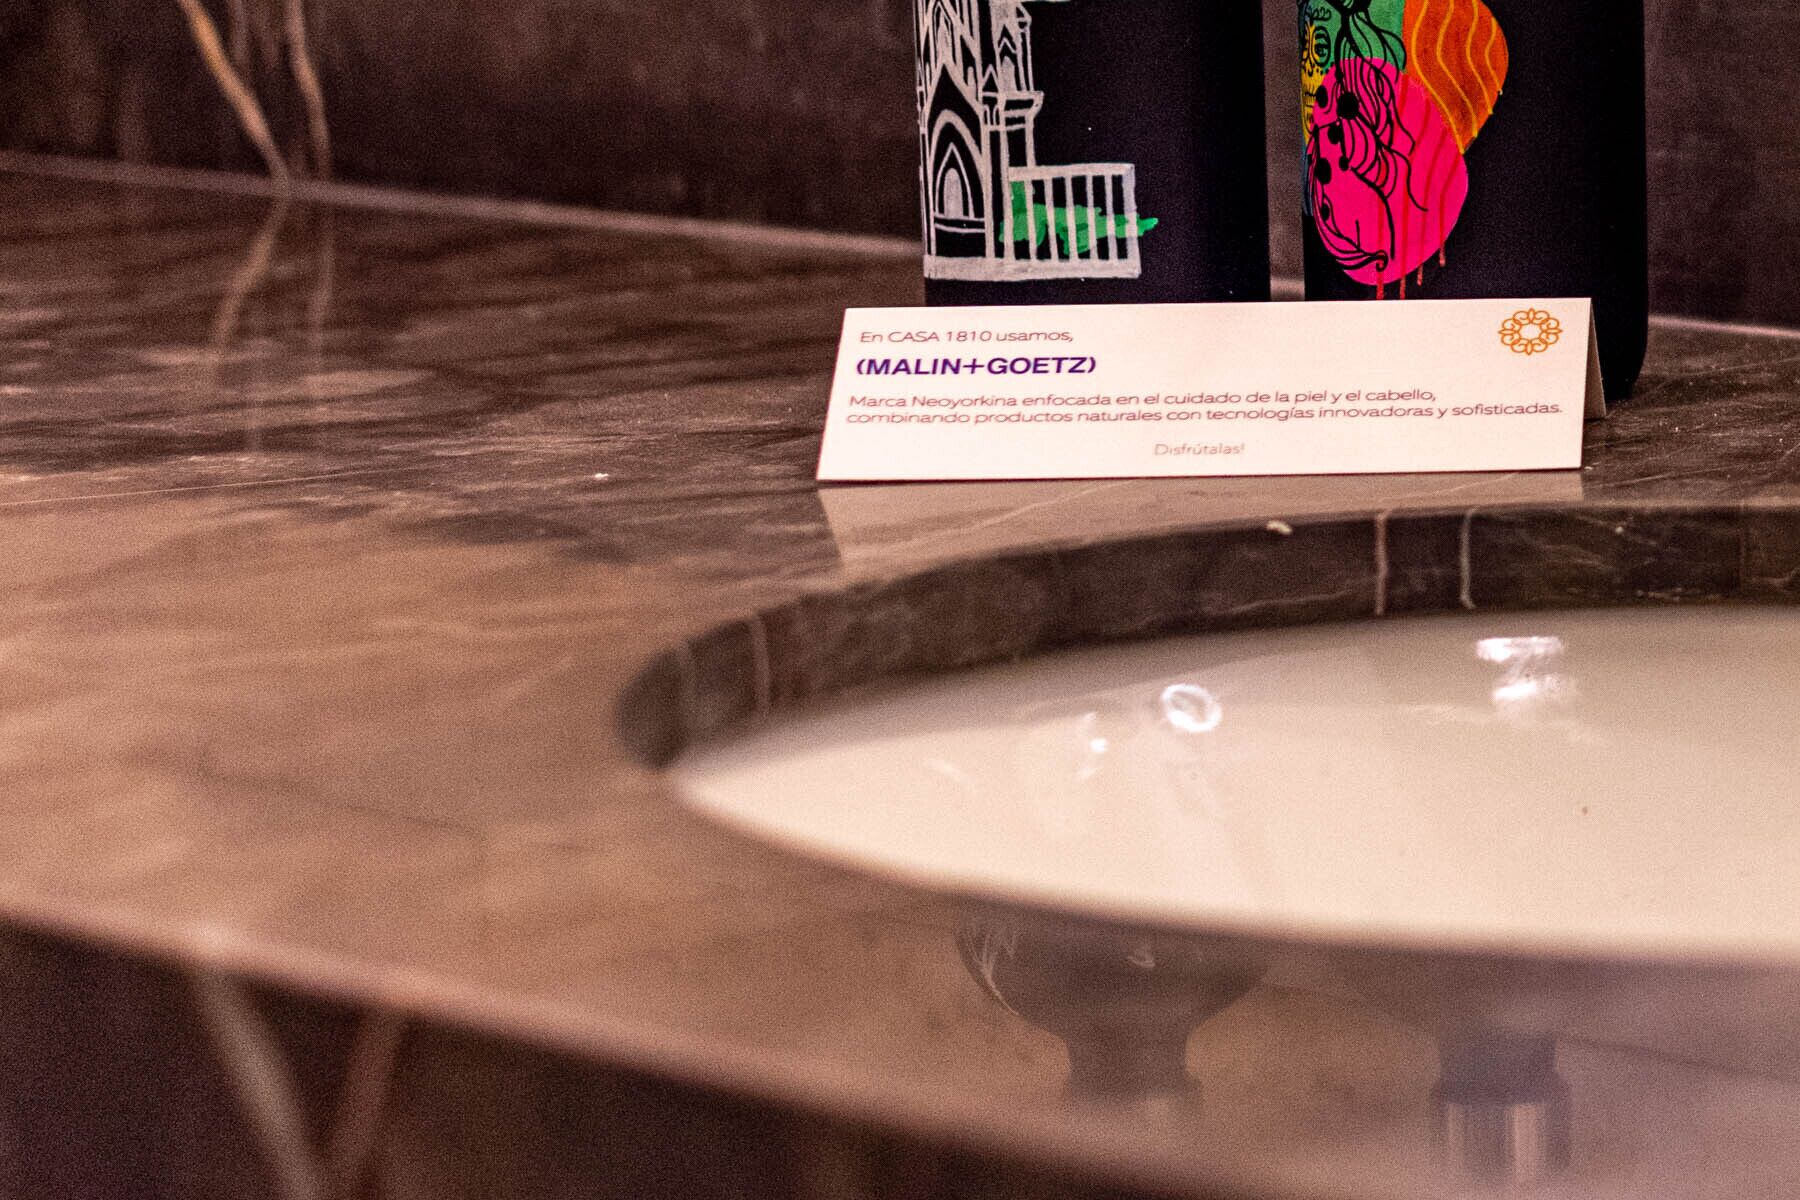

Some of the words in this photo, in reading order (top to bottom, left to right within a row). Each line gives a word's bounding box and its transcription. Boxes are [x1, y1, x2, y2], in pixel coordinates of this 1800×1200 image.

[860, 331, 883, 343] En
[888, 331, 940, 343] CASA
[946, 330, 993, 342] 1810
[996, 331, 1074, 343] usamos,
[856, 356, 1097, 376] (MALIN+GOETZ)
[849, 395, 906, 407] Marca
[911, 395, 1017, 410] Neoyorkina
[1022, 394, 1112, 406] enfocada
[1116, 395, 1140, 405] en
[1143, 393, 1160, 405] el
[1164, 392, 1242, 404] cuidado
[1246, 391, 1271, 403] de
[1275, 391, 1290, 403] la
[1294, 390, 1328, 405] piel
[1331, 392, 1343, 405] y
[1345, 390, 1361, 401] el
[1365, 388, 1437, 402] cabello,
[846, 412, 970, 424] combinando
[974, 411, 1073, 425] productos
[1077, 409, 1163, 422] naturales
[1166, 410, 1201, 421] con
[1206, 406, 1315, 422] tecnologías
[1319, 405, 1433, 418] innovadoras
[1437, 407, 1449, 419] y
[1452, 402, 1563, 416] sofisticadas.
[1154, 442, 1245, 456] Disfrútalas!
